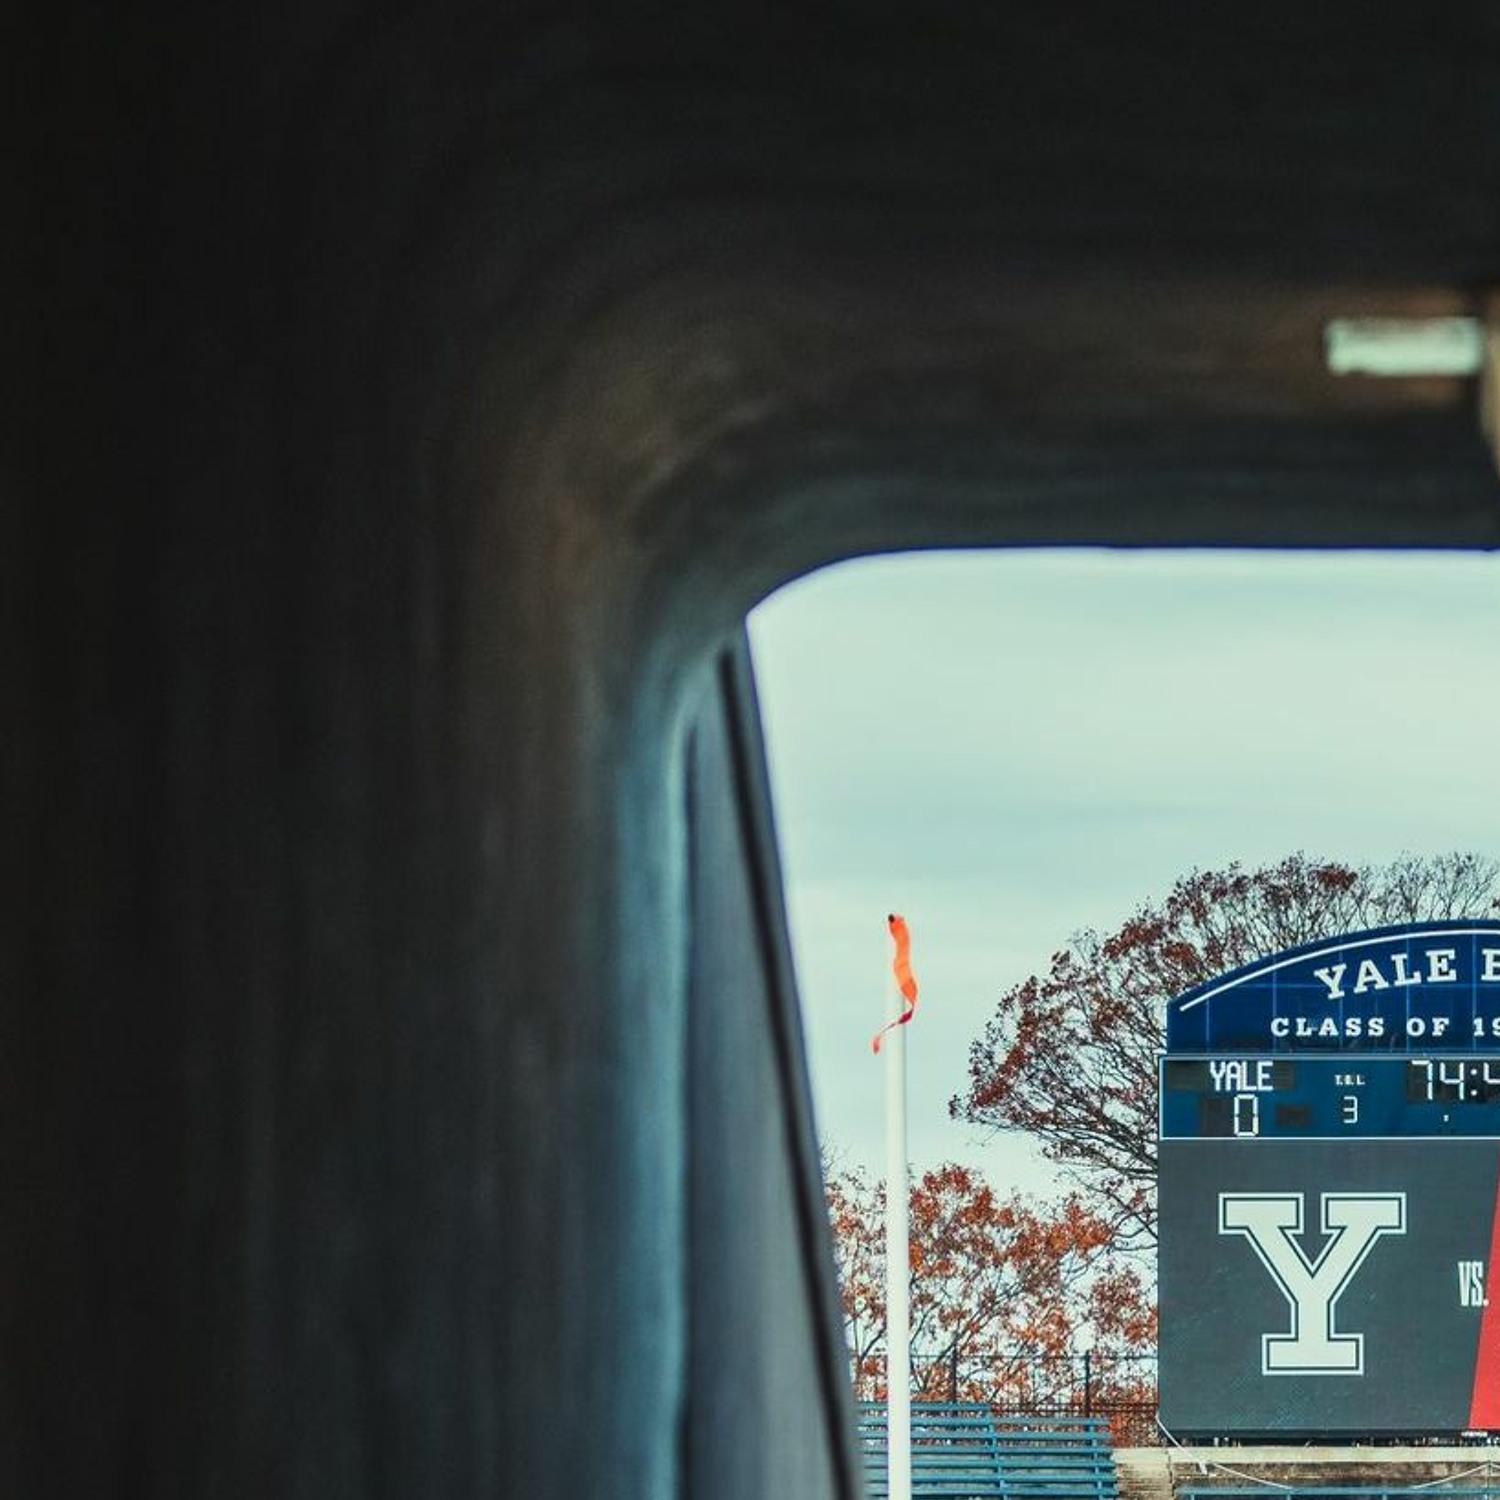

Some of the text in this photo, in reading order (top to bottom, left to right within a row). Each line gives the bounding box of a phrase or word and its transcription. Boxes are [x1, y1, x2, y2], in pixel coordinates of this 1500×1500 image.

[1314, 949, 1457, 1000] YALE
[1270, 1016, 1386, 1037] CLASS
[1406, 1016, 1450, 1037] OF
[1210, 1061, 1273, 1091] YALE
[1233, 1094, 1258, 1137] 0
[1344, 1096, 1358, 1123] 3
[1218, 1192, 1407, 1376] Y
[1457, 1261, 1490, 1306] VS.
